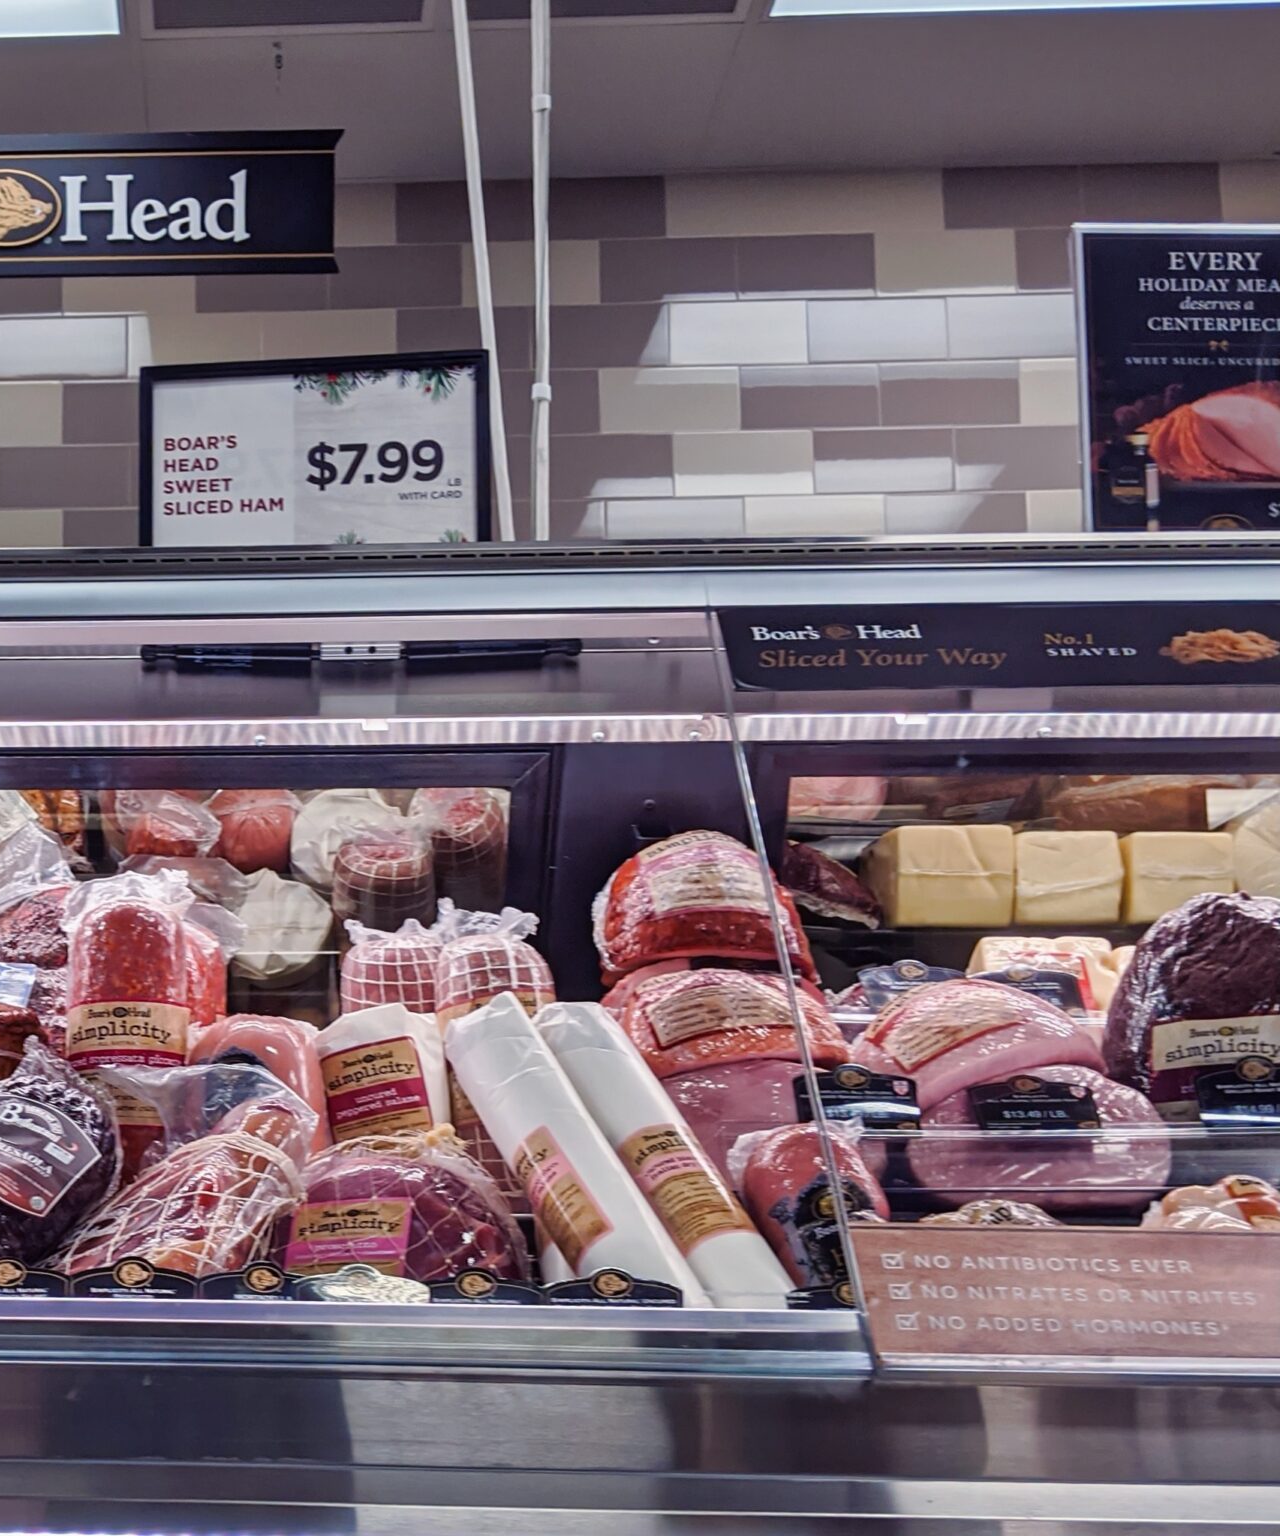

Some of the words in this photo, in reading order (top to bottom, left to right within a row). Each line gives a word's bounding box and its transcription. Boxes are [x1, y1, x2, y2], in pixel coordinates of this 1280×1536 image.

[59, 169, 250, 243] Head
[1168, 252, 1262, 271] EVERY
[1138, 278, 1230, 292] HOLIDAY
[1237, 279, 1280, 292] MEA
[1179, 296, 1241, 310] deserves
[1243, 300, 1254, 310] a
[1125, 357, 1167, 365] SWEET
[163, 435, 238, 452] BOAR'S
[163, 458, 219, 473] HEAD
[306, 439, 444, 491] $7.99
[163, 478, 232, 494] SWEET
[447, 478, 462, 487] LB
[398, 491, 428, 500] WITH
[430, 490, 463, 499] CARD
[163, 499, 234, 515] SLICED
[240, 498, 284, 513] HAM
[749, 625, 820, 640] Boar's
[856, 624, 922, 639] Head
[758, 649, 847, 668] Sliced
[856, 649, 928, 666] Your
[936, 648, 1007, 670] Way
[1046, 647, 1138, 656] SHAVED
[72, 1021, 171, 1044] simplicity
[1165, 1038, 1280, 1062] simplicity
[328, 1061, 415, 1090] simplicity
[336, 1101, 383, 1119] peppered
[299, 1218, 400, 1236] simplicity
[913, 1255, 951, 1269] NO
[961, 1256, 1121, 1273] ANTIBIOTICS
[1130, 1259, 1193, 1273] EVER
[920, 1285, 959, 1299] NO
[967, 1286, 1088, 1302] NITRATES
[1098, 1288, 1133, 1303] OR
[928, 1316, 967, 1330] NO
[976, 1317, 1062, 1332] ADDED
